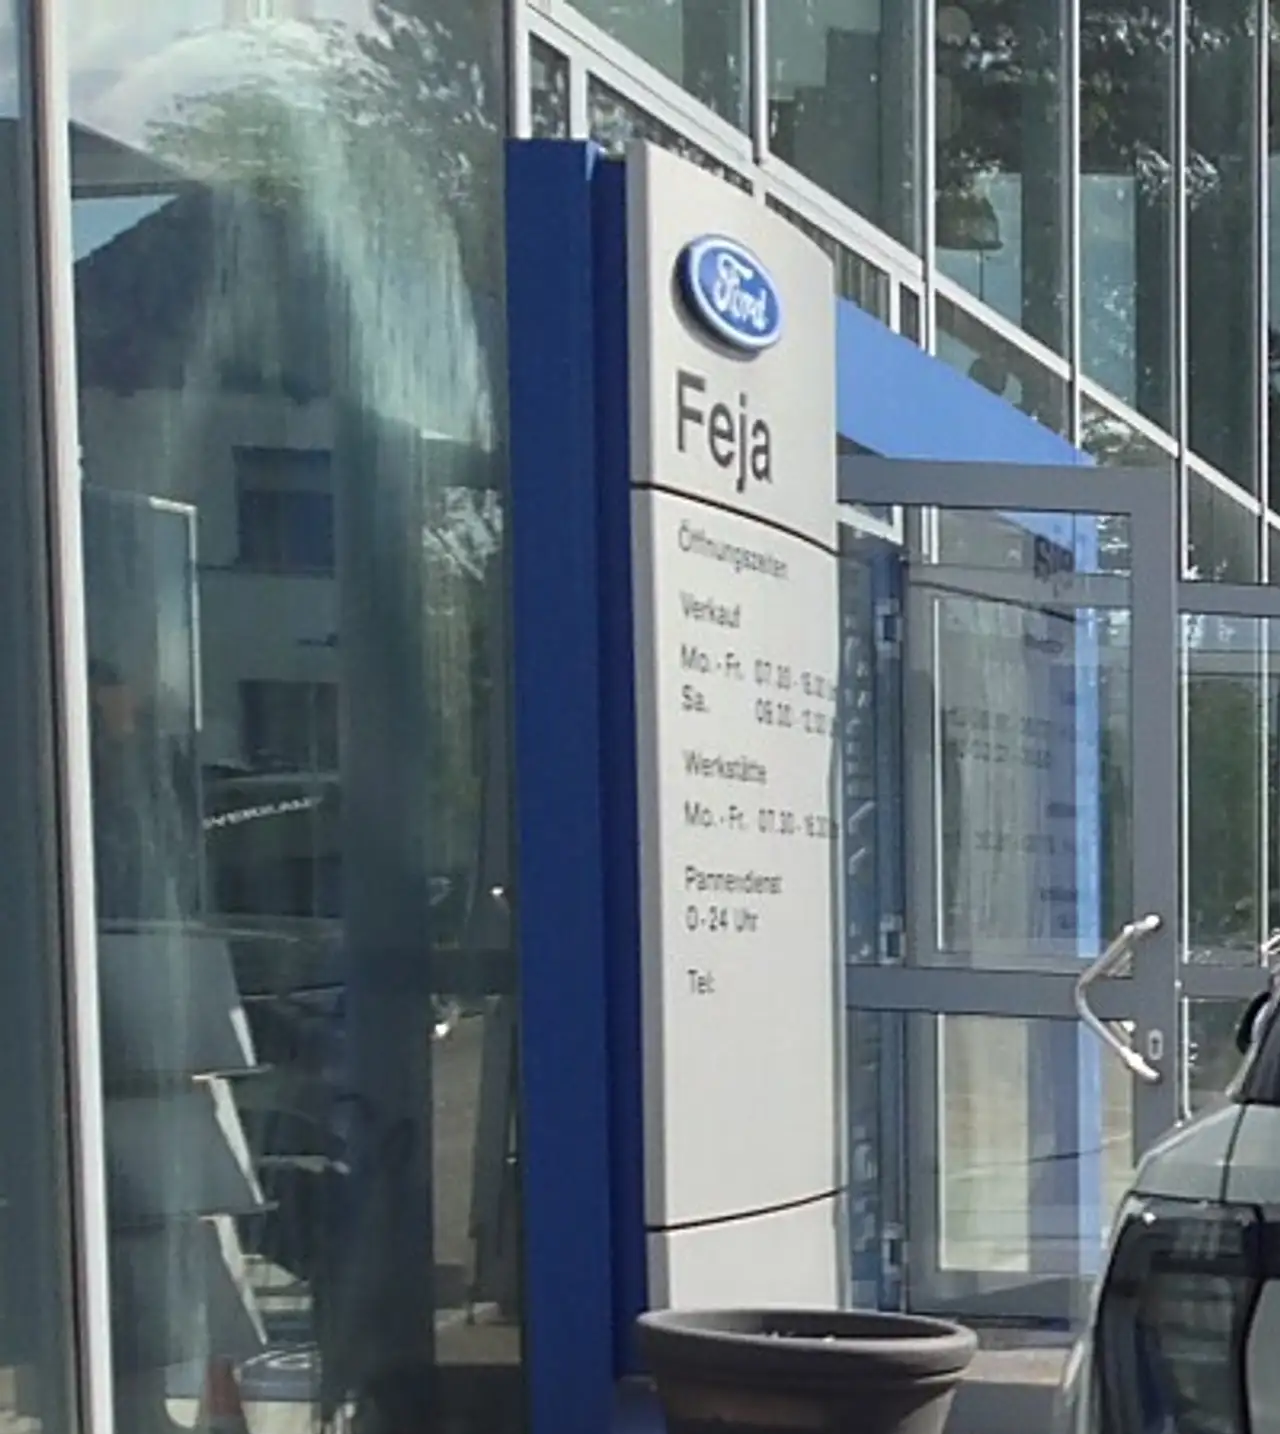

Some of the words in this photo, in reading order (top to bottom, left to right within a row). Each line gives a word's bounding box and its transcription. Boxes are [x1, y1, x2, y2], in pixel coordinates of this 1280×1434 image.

[677, 369, 773, 494] Feja
[679, 590, 741, 629] Verkauf
[709, 904, 728, 932] 24
[733, 906, 759, 933] Uhr
